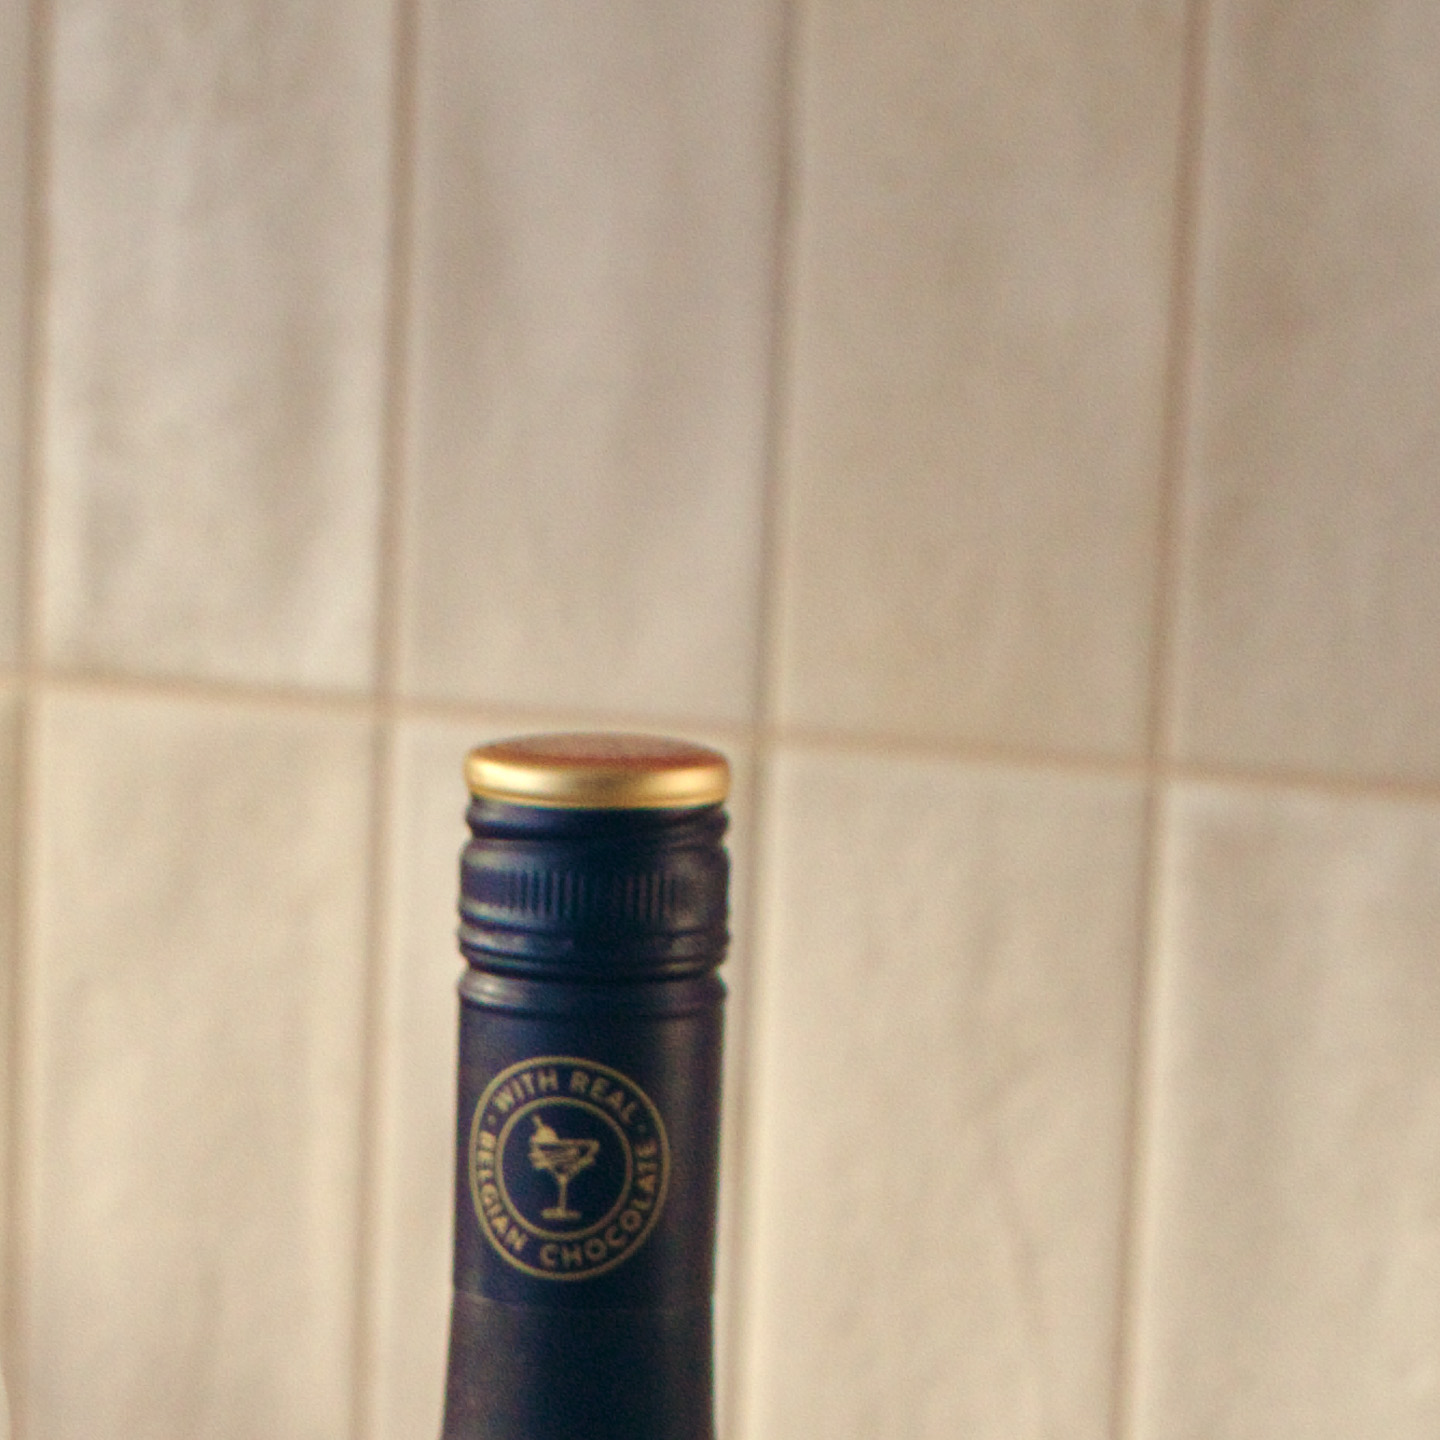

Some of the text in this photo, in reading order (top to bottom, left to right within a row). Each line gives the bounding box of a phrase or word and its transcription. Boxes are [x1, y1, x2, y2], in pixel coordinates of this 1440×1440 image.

[494, 1069, 636, 1125] WITH REAL
[540, 1140, 658, 1268] CHOCOLATE
